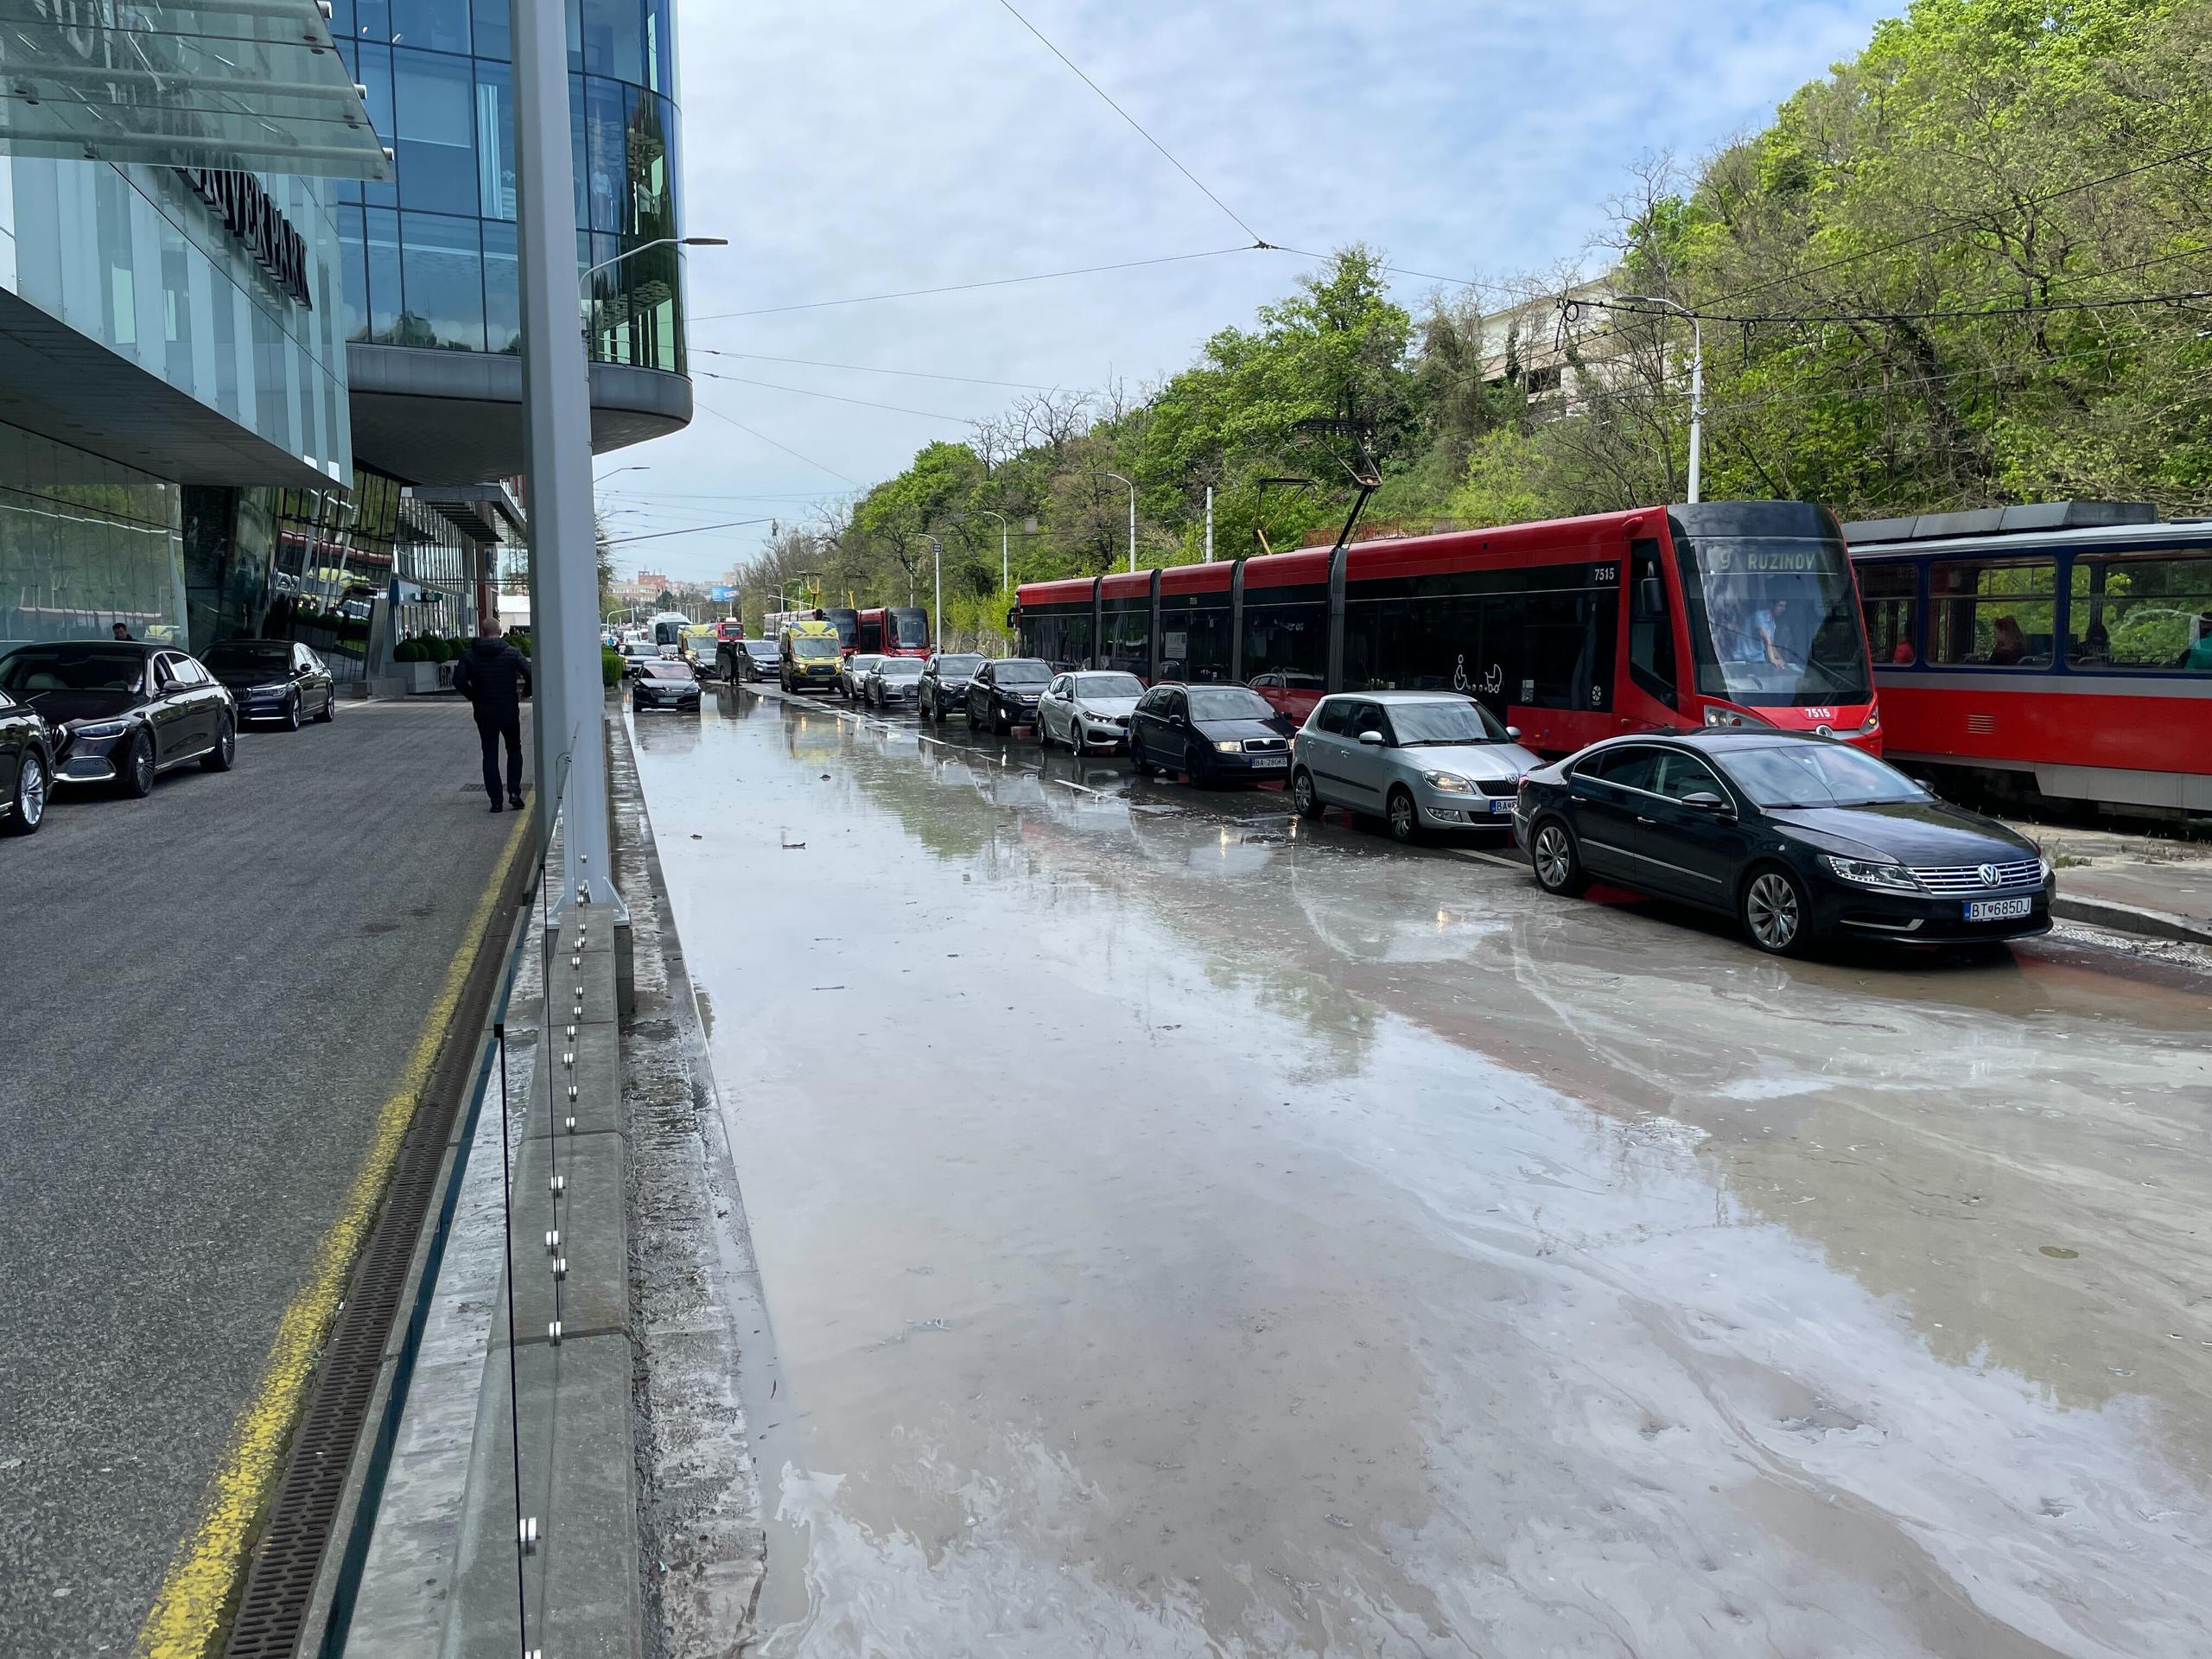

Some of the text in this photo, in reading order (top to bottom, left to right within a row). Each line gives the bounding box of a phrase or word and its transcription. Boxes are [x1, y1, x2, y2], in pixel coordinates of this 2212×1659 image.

[265, 194, 312, 309] PARK
[1594, 567, 1615, 581] 7515
[1804, 708, 1831, 718] 7515
